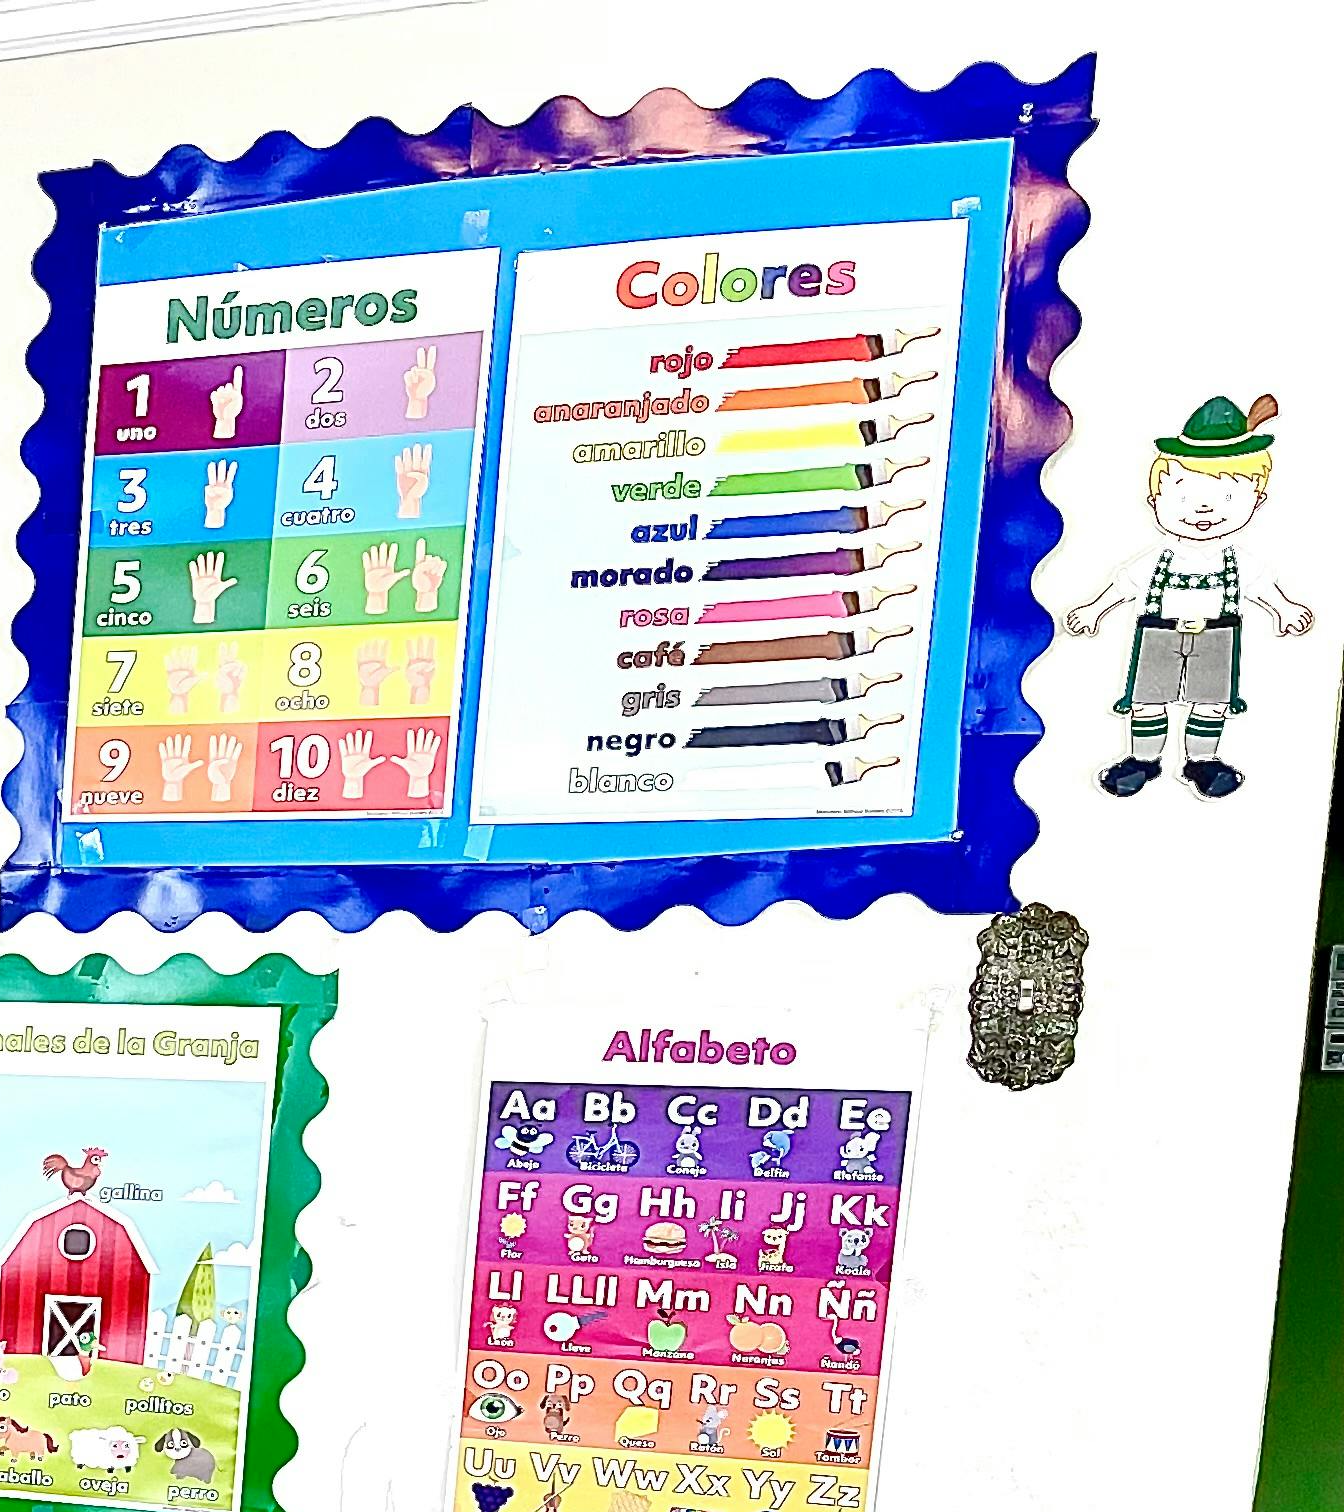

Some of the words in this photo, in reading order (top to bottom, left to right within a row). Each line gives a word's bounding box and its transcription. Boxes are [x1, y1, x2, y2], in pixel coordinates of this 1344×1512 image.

[616, 251, 857, 309] Colores
[166, 288, 419, 345] Números
[650, 346, 713, 379] rojo
[126, 373, 151, 418] 1
[310, 356, 345, 406] 2
[304, 408, 347, 430] dos
[533, 388, 710, 424] anaranjado
[116, 424, 158, 442] uno
[572, 430, 706, 463] amarillo
[116, 467, 148, 514] 3
[302, 455, 339, 501] 4
[611, 473, 701, 503] verde
[109, 518, 153, 536] tres
[280, 505, 355, 527] cuatro
[631, 514, 699, 543] azul
[110, 559, 142, 605] 5
[295, 549, 330, 595] 6
[571, 558, 694, 589] morado
[95, 607, 153, 628] cinco
[287, 597, 332, 619] seis
[619, 606, 690, 628] rosa
[287, 641, 322, 688] 8
[616, 640, 686, 671] café
[105, 649, 138, 694] 7
[91, 698, 144, 717] siete
[275, 691, 330, 712] ocho
[621, 683, 681, 717] gris
[269, 733, 330, 780] 10
[586, 730, 677, 757] negro
[98, 738, 132, 783] 9
[272, 781, 320, 803] diez
[568, 767, 674, 795] blanco
[80, 789, 143, 806] nueve
[72, 1027, 111, 1054] de
[116, 1028, 146, 1056] la
[152, 1030, 260, 1065] Granja
[602, 1028, 797, 1066] Alfabeto
[500, 1090, 557, 1121] Aa
[583, 1091, 637, 1124] Bb
[666, 1094, 719, 1126] Cc
[748, 1095, 810, 1129] Dd
[839, 1098, 892, 1131] Ee
[99, 1182, 164, 1203] gallina
[497, 1181, 541, 1211] Ff
[562, 1184, 619, 1224] Gg
[640, 1186, 697, 1219] Hh
[720, 1189, 746, 1221] Ii
[770, 1191, 807, 1232] Jj
[830, 1193, 890, 1227] Kk
[488, 1270, 524, 1301] Ll
[635, 1278, 710, 1312] Mm
[735, 1282, 793, 1316] Nn
[817, 1279, 878, 1321] Ññ
[48, 1391, 92, 1409] pato
[473, 1359, 530, 1391] Oo
[545, 1363, 596, 1404] Pp
[613, 1368, 673, 1410] Qq
[689, 1373, 738, 1406] Rr
[753, 1376, 801, 1411] Ss
[821, 1381, 868, 1415] Tt
[124, 1396, 194, 1416] pollitos
[485, 1426, 507, 1438] Ojo
[761, 1447, 782, 1458] Sol
[79, 1476, 129, 1496] oveja
[167, 1485, 219, 1502] perro
[464, 1447, 517, 1480] Uu
[529, 1451, 582, 1485] Vv
[592, 1456, 670, 1491] Ww
[673, 1463, 732, 1497] Xx
[741, 1468, 796, 1510] Yy
[807, 1473, 861, 1508] Zz
